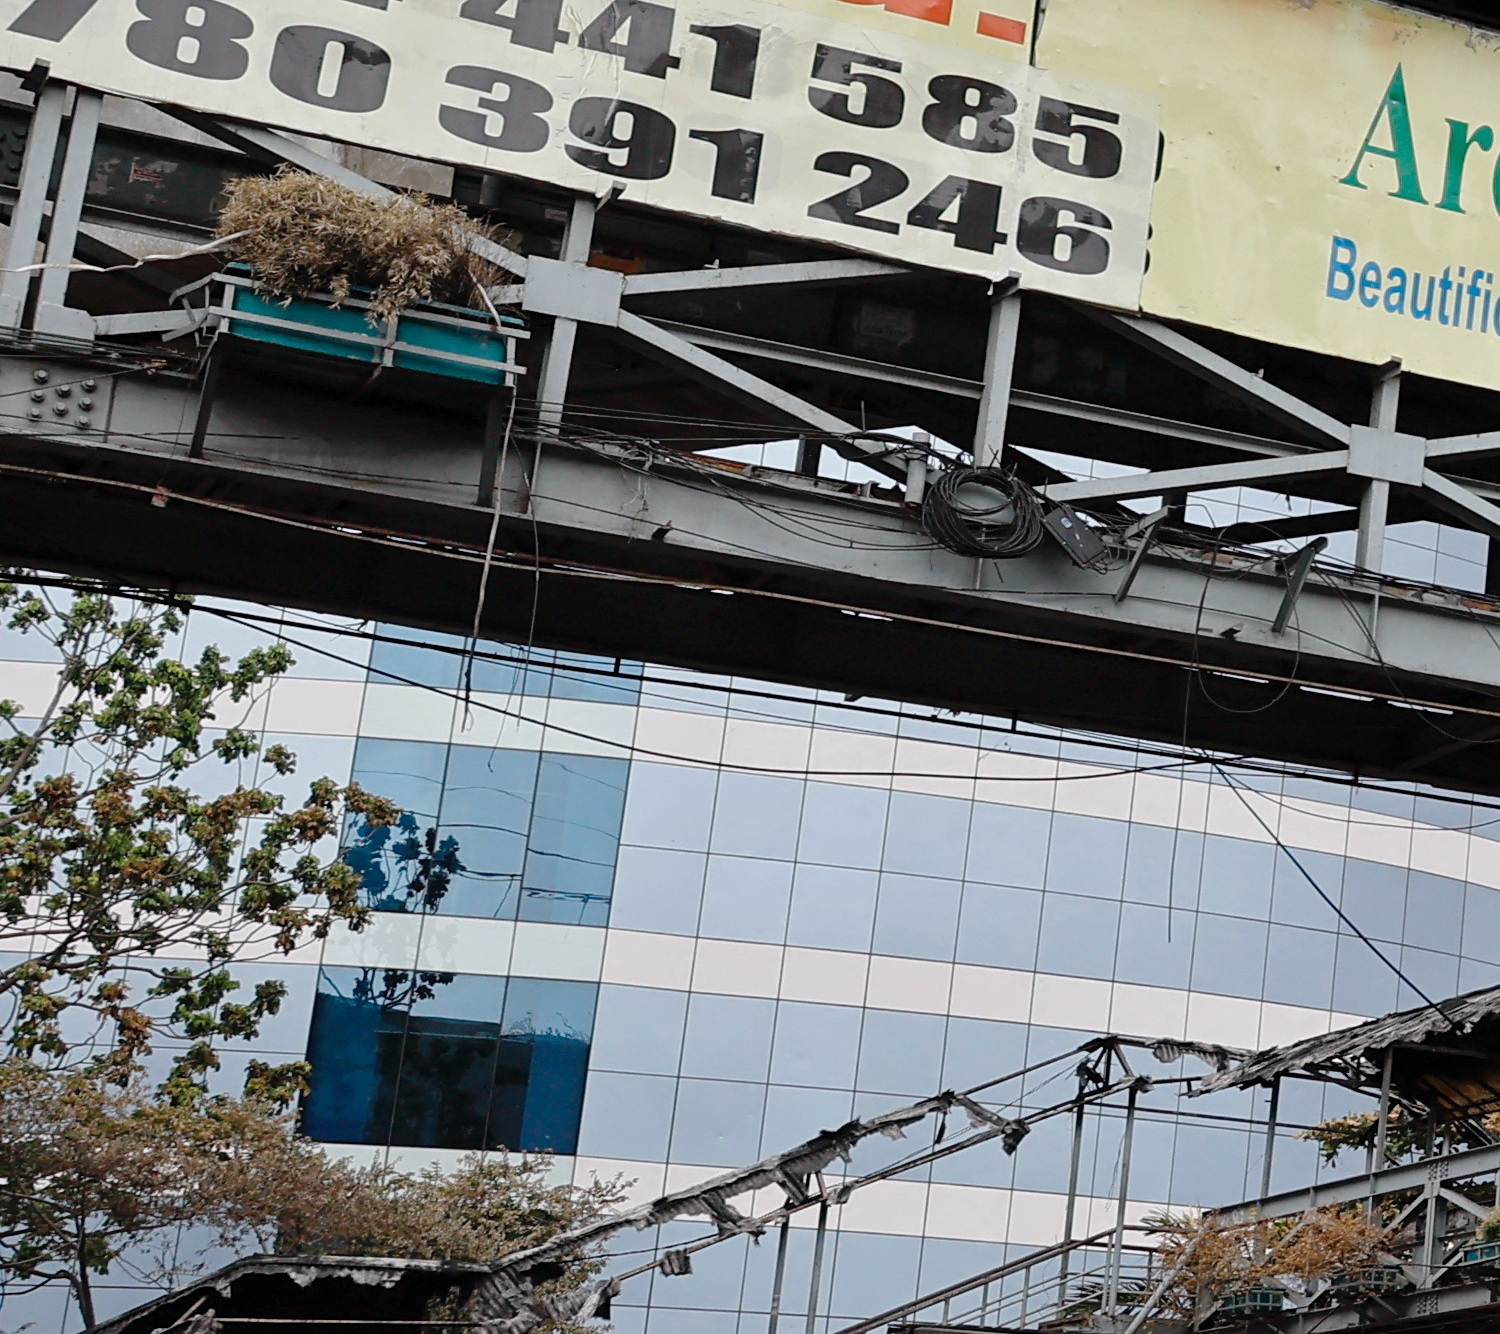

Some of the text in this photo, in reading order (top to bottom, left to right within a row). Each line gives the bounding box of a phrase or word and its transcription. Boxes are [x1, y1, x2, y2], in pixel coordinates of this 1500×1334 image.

[438, 64, 764, 205] 391
[807, 150, 1115, 276] 246
[808, 41, 1122, 181] 585
